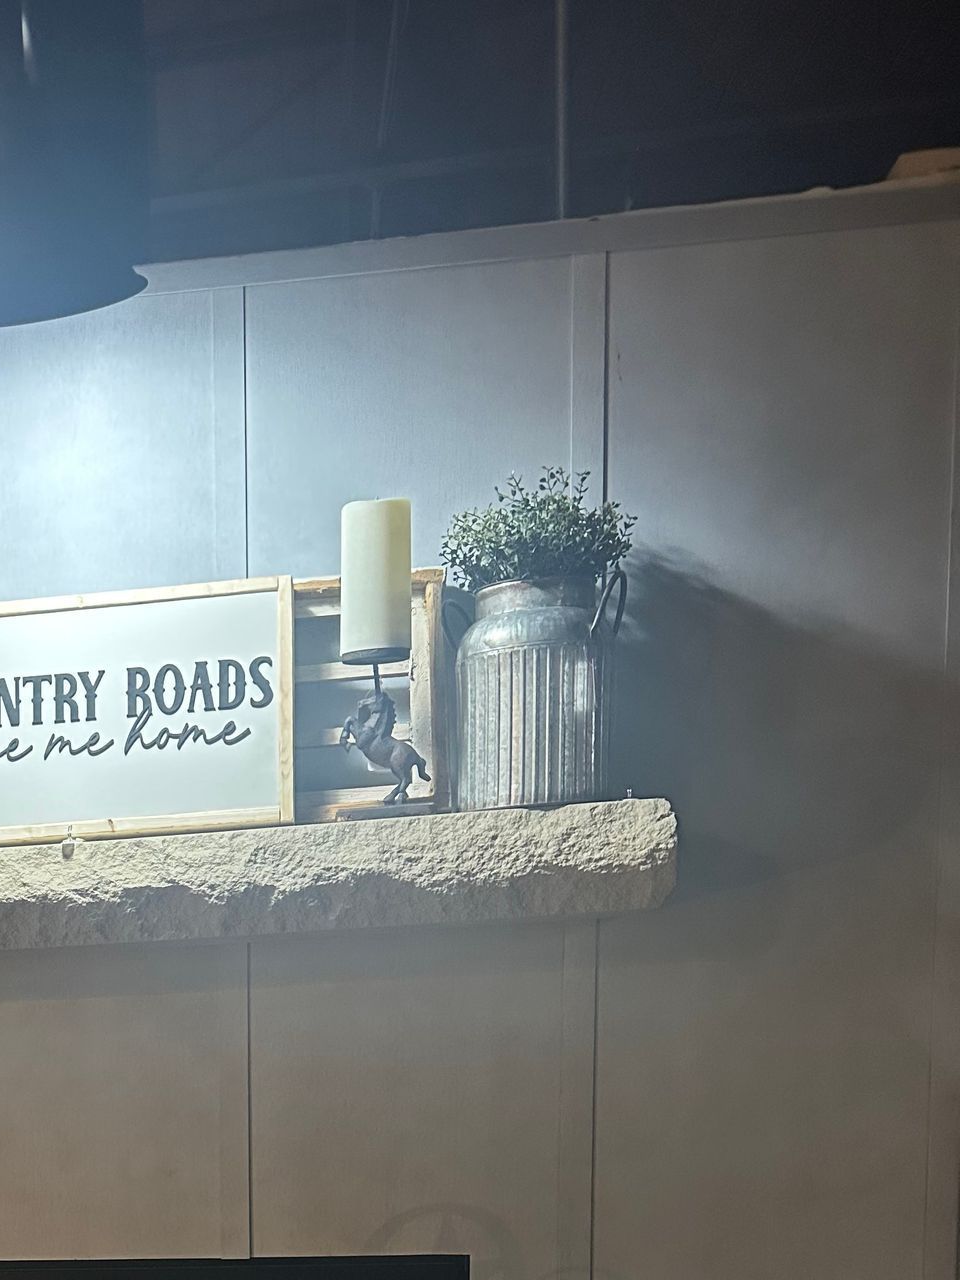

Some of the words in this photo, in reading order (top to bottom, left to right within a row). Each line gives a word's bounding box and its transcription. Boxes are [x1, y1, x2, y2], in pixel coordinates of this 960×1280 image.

[125, 656, 274, 719] ROADS
[43, 731, 115, 761] me
[124, 705, 252, 757] home
